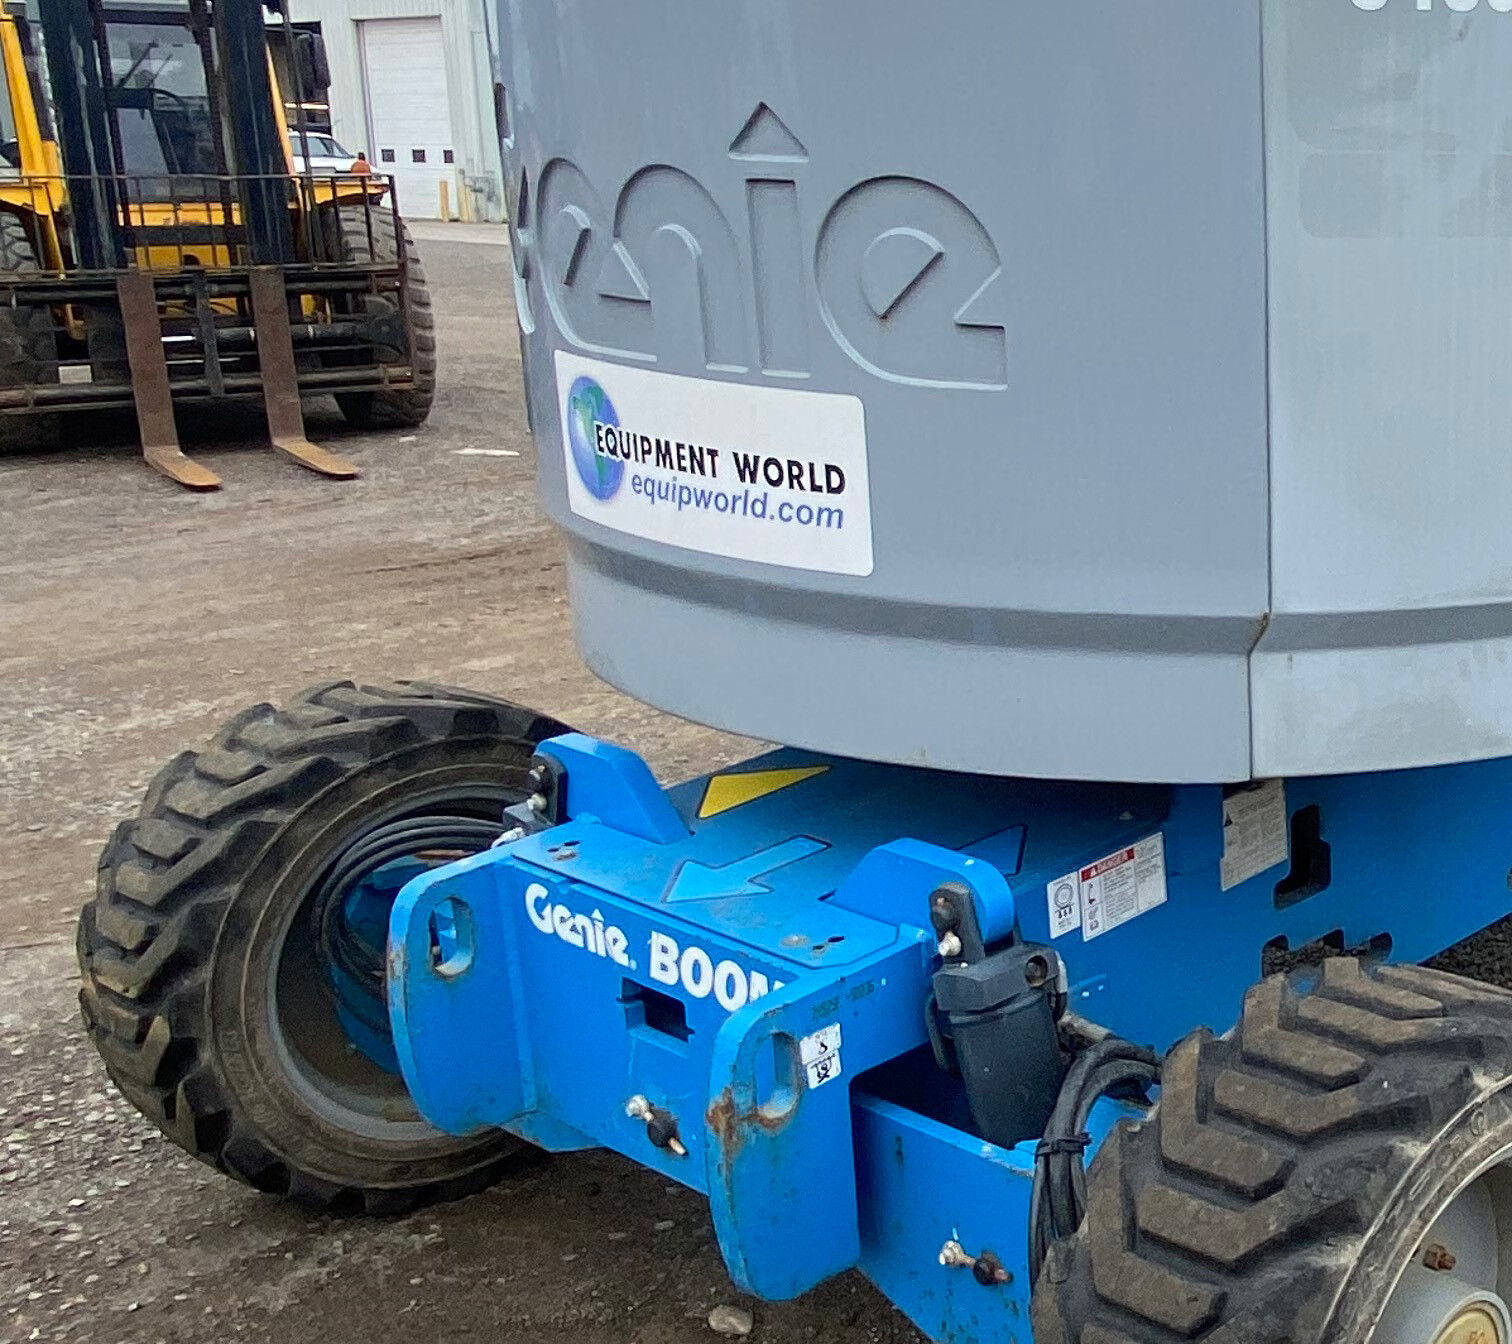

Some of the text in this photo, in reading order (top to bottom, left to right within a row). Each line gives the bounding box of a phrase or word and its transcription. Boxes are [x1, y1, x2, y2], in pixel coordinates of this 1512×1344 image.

[494, 83, 1008, 389] enie
[595, 423, 846, 494] EQUIPMENT WORLD
[632, 472, 843, 529] equipworld.com
[525, 883, 632, 968] Genie
